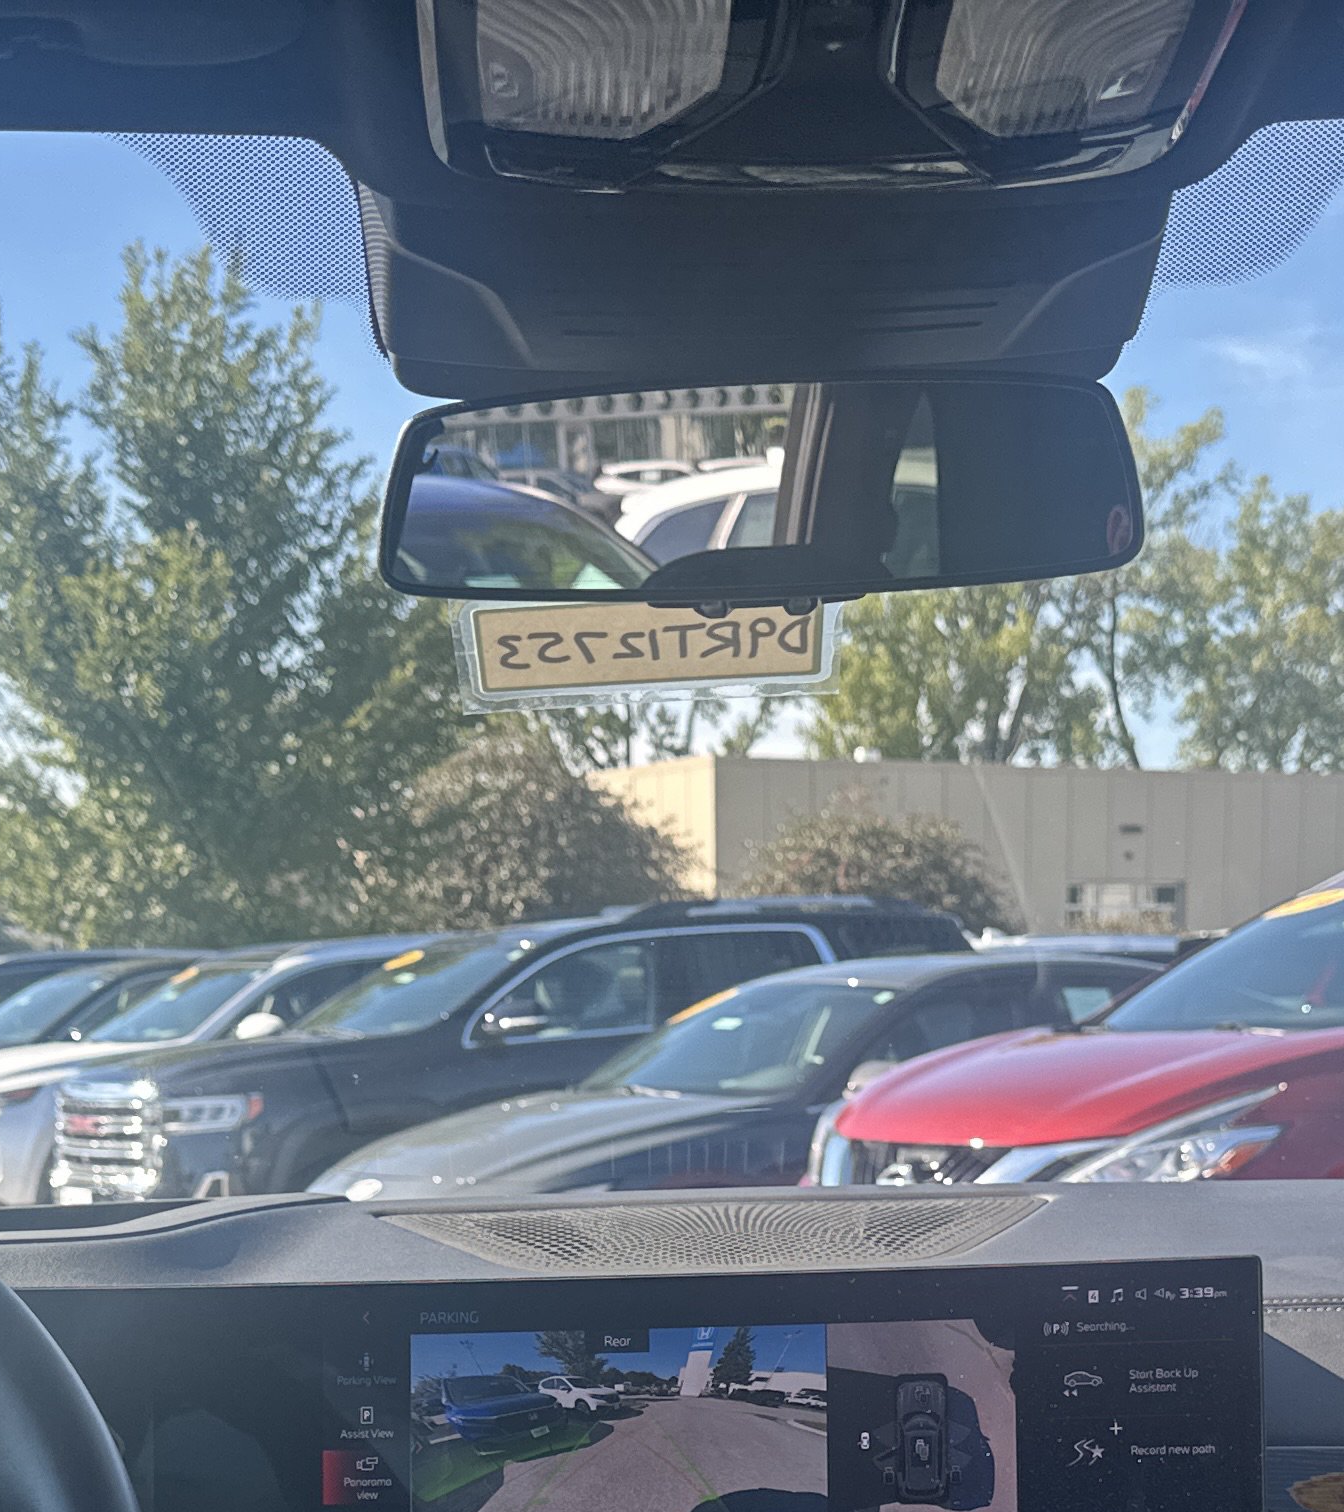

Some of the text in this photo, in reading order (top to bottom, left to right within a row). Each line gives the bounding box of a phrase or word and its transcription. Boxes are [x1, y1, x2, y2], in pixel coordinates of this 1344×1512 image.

[419, 1311, 479, 1325] PARKING
[604, 1335, 632, 1348] Rear
[1129, 1368, 1199, 1380] Start Back Up
[336, 1375, 398, 1388] Parking View
[1129, 1383, 1177, 1394] Assistant
[340, 1428, 394, 1440] Assist View
[1130, 1444, 1216, 1456] Record new path
[343, 1477, 393, 1488] Panorama
[356, 1490, 379, 1500] view
